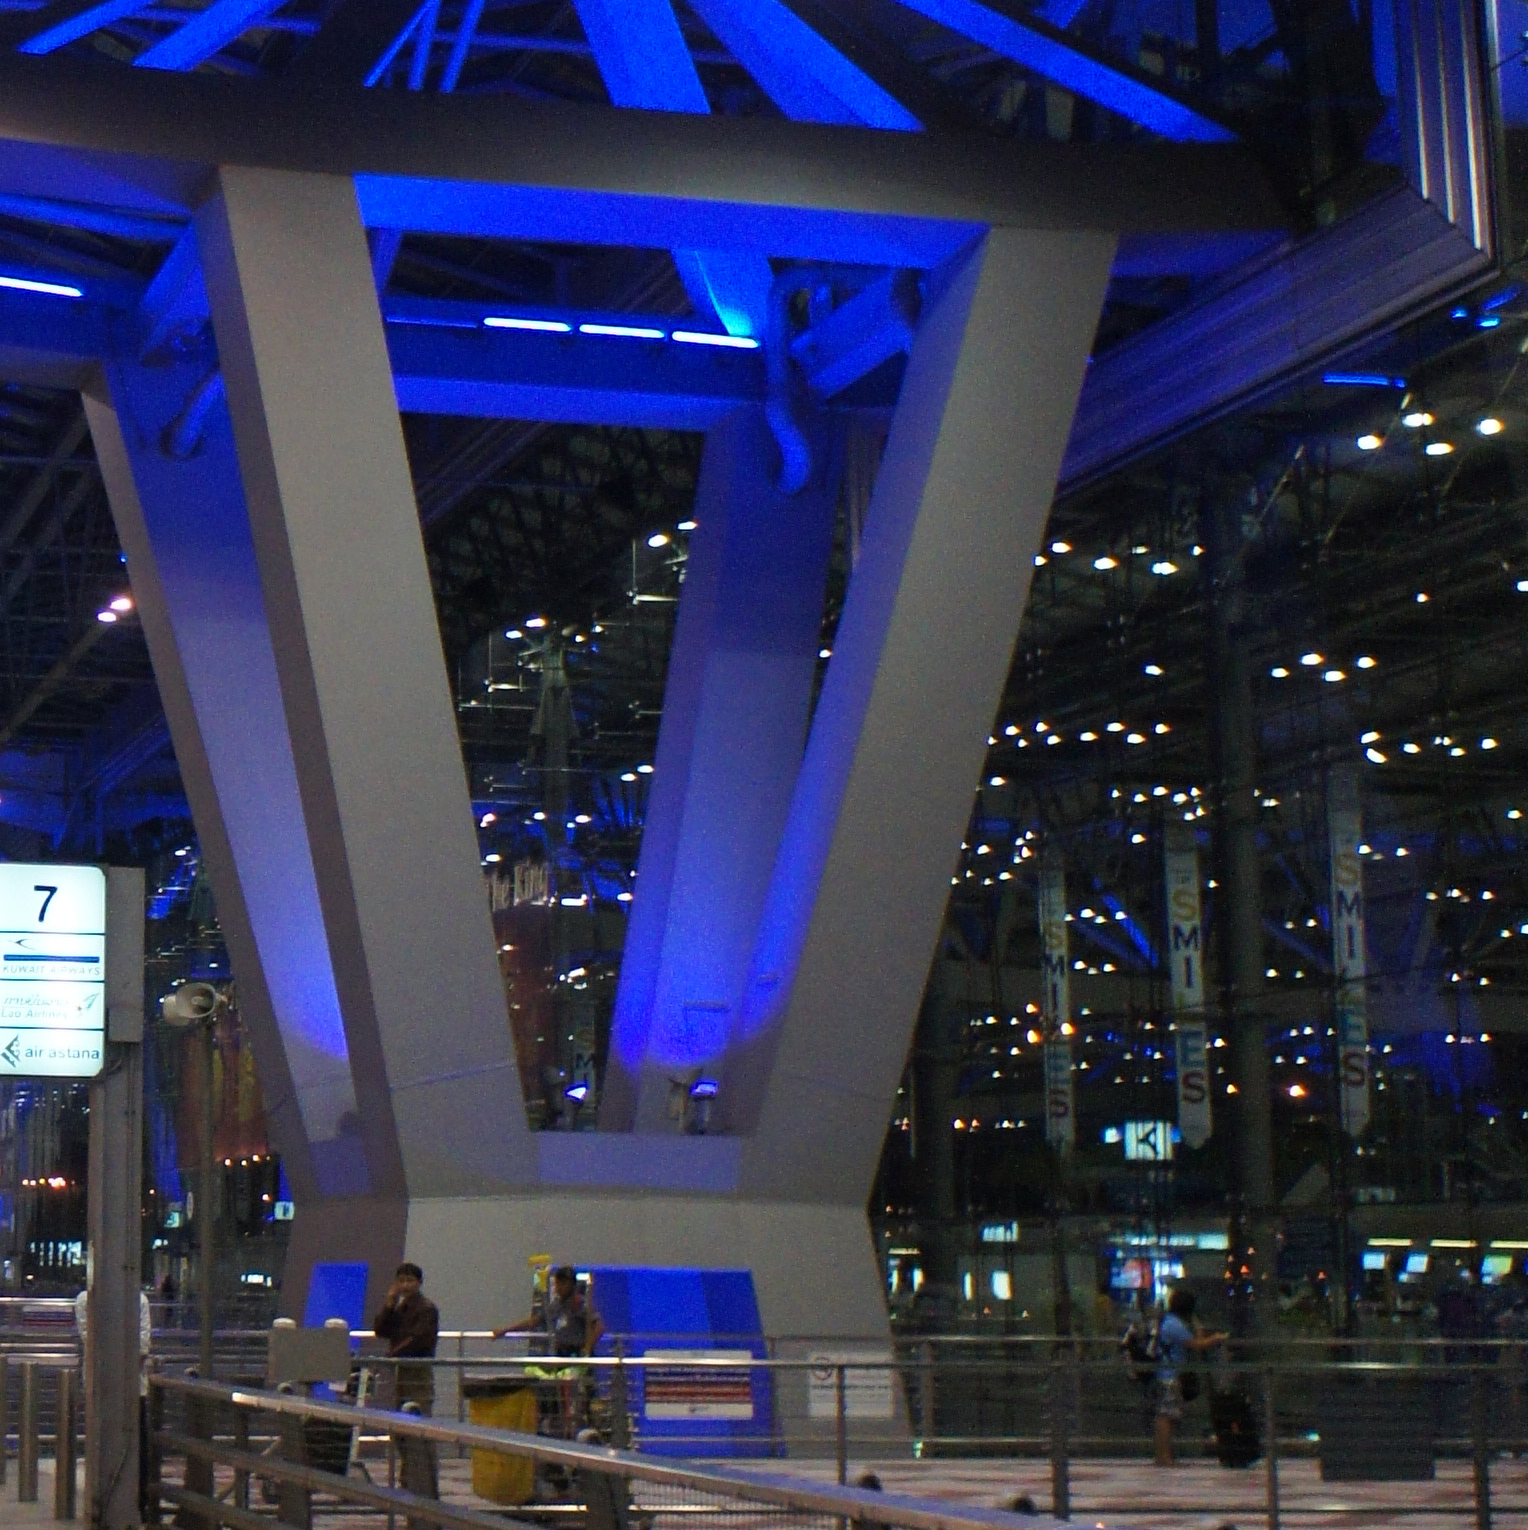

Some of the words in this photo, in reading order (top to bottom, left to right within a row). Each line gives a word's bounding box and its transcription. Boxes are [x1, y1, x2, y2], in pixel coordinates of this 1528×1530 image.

[32, 884, 58, 923] 7
[2, 964, 46, 975] KUWAIT
[48, 965, 102, 976] AIRWAYS
[0, 1006, 22, 1018] Lao
[24, 1046, 45, 1060] air
[47, 1047, 101, 1062] astana
